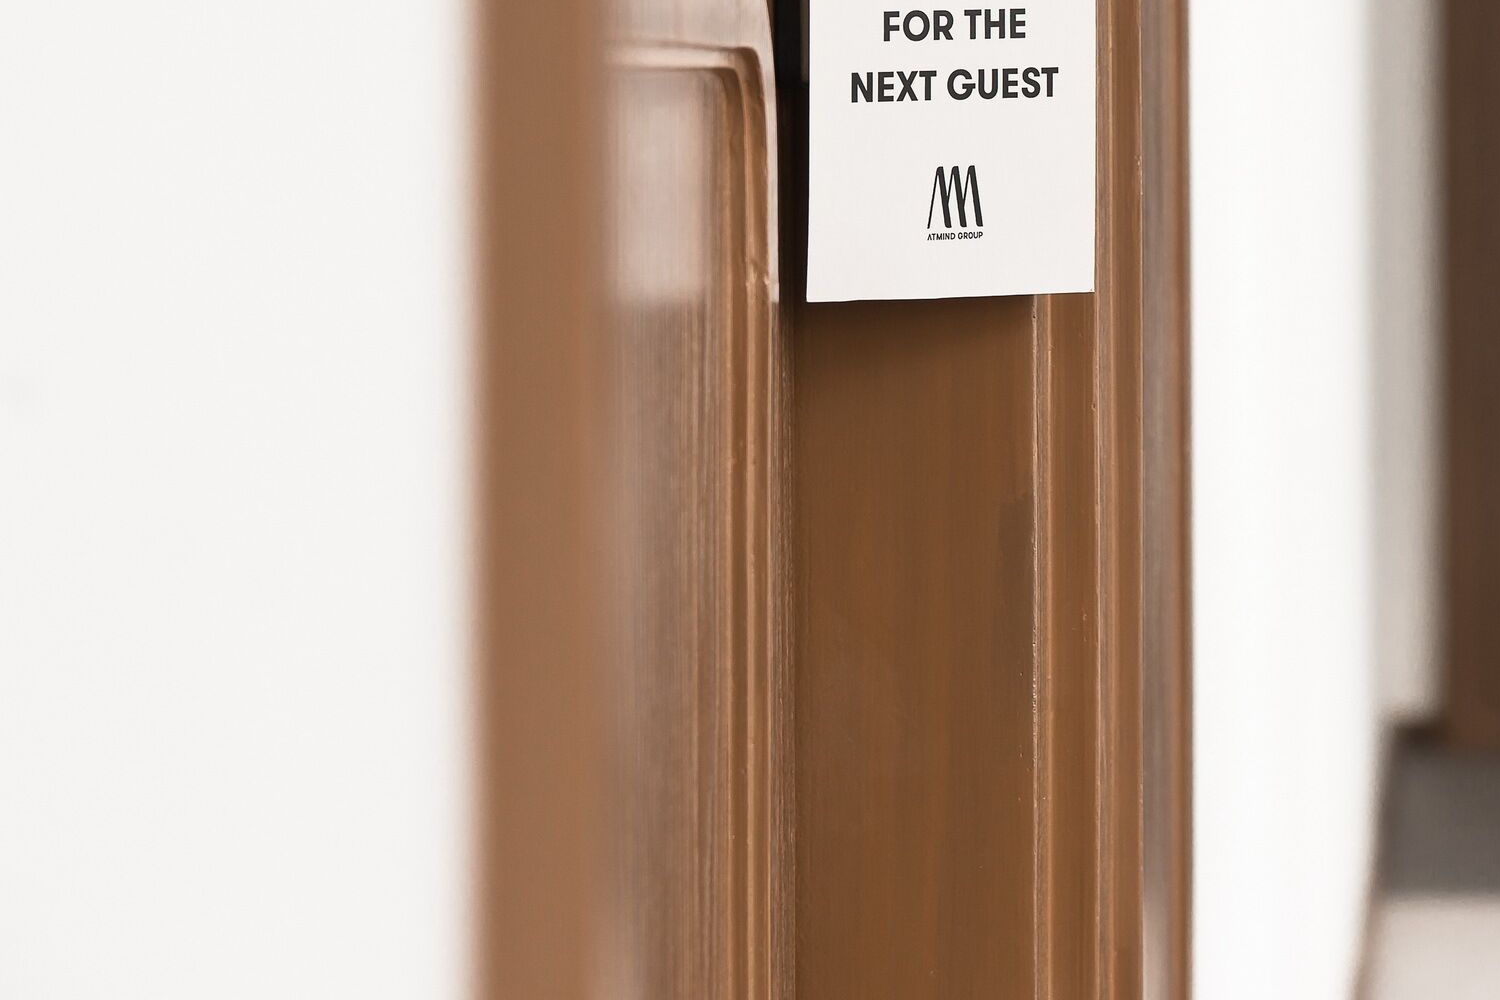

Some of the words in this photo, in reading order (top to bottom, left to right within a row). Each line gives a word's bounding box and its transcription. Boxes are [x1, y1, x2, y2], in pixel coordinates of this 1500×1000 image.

[884, 10, 954, 42] FOR
[964, 8, 1026, 40] THE
[851, 70, 937, 104] NEXT
[947, 67, 1059, 101] GUEST
[927, 233, 956, 241] ATMIND
[957, 232, 984, 240] GROUP
